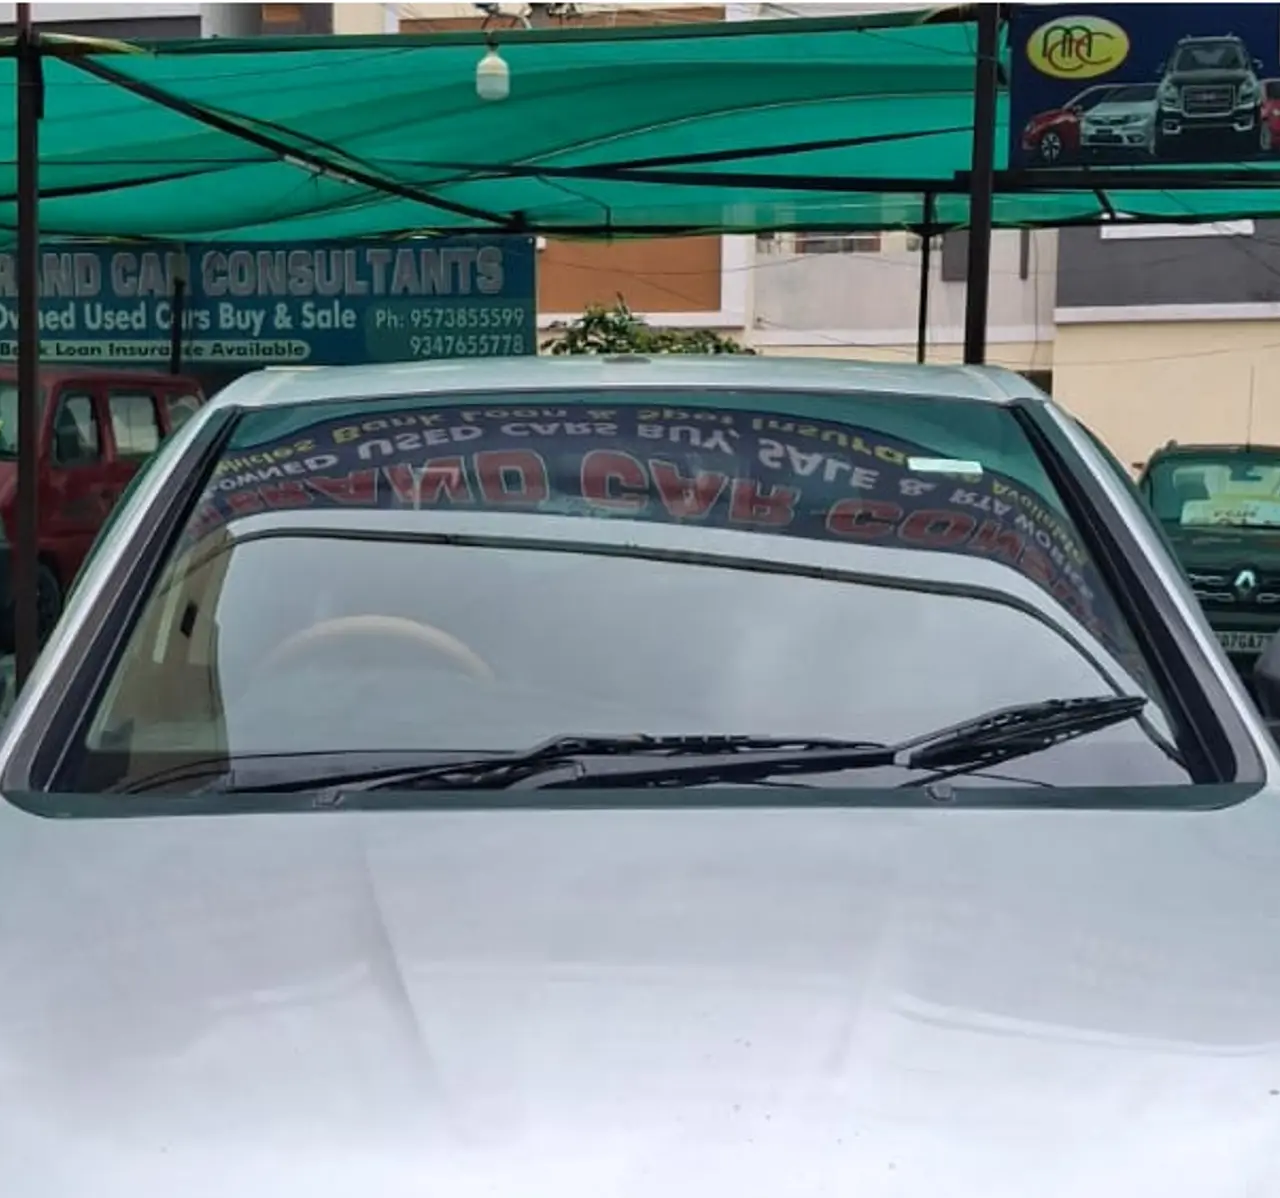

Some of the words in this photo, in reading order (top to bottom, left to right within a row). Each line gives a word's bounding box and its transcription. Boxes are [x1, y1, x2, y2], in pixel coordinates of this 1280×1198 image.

[201, 247, 504, 297] CONSULTANTS
[84, 301, 146, 330] Used
[219, 301, 267, 337] Buy
[274, 303, 294, 330] &
[301, 300, 357, 330] Sale
[376, 308, 403, 328] Ph:
[410, 307, 524, 329] 9573855599
[56, 342, 103, 357] Loan
[211, 340, 307, 357] Available
